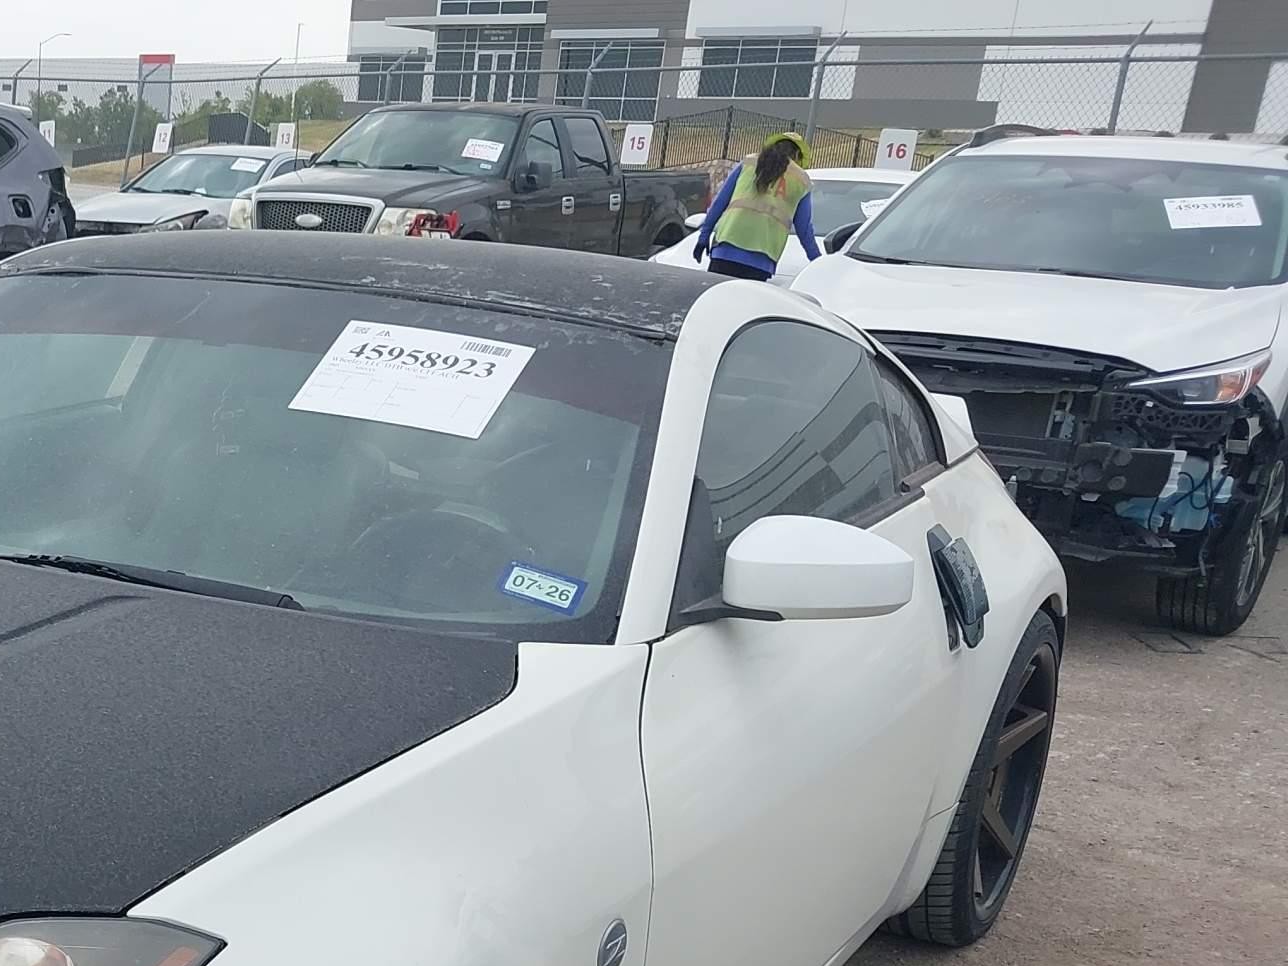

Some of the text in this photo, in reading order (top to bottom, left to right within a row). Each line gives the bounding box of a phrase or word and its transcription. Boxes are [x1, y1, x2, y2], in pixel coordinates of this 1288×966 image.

[159, 132, 168, 143] 12
[281, 132, 291, 144] 13
[630, 136, 646, 150] 15
[886, 142, 907, 159] 16
[347, 341, 497, 379] 45958923
[512, 574, 572, 602] 07 26
